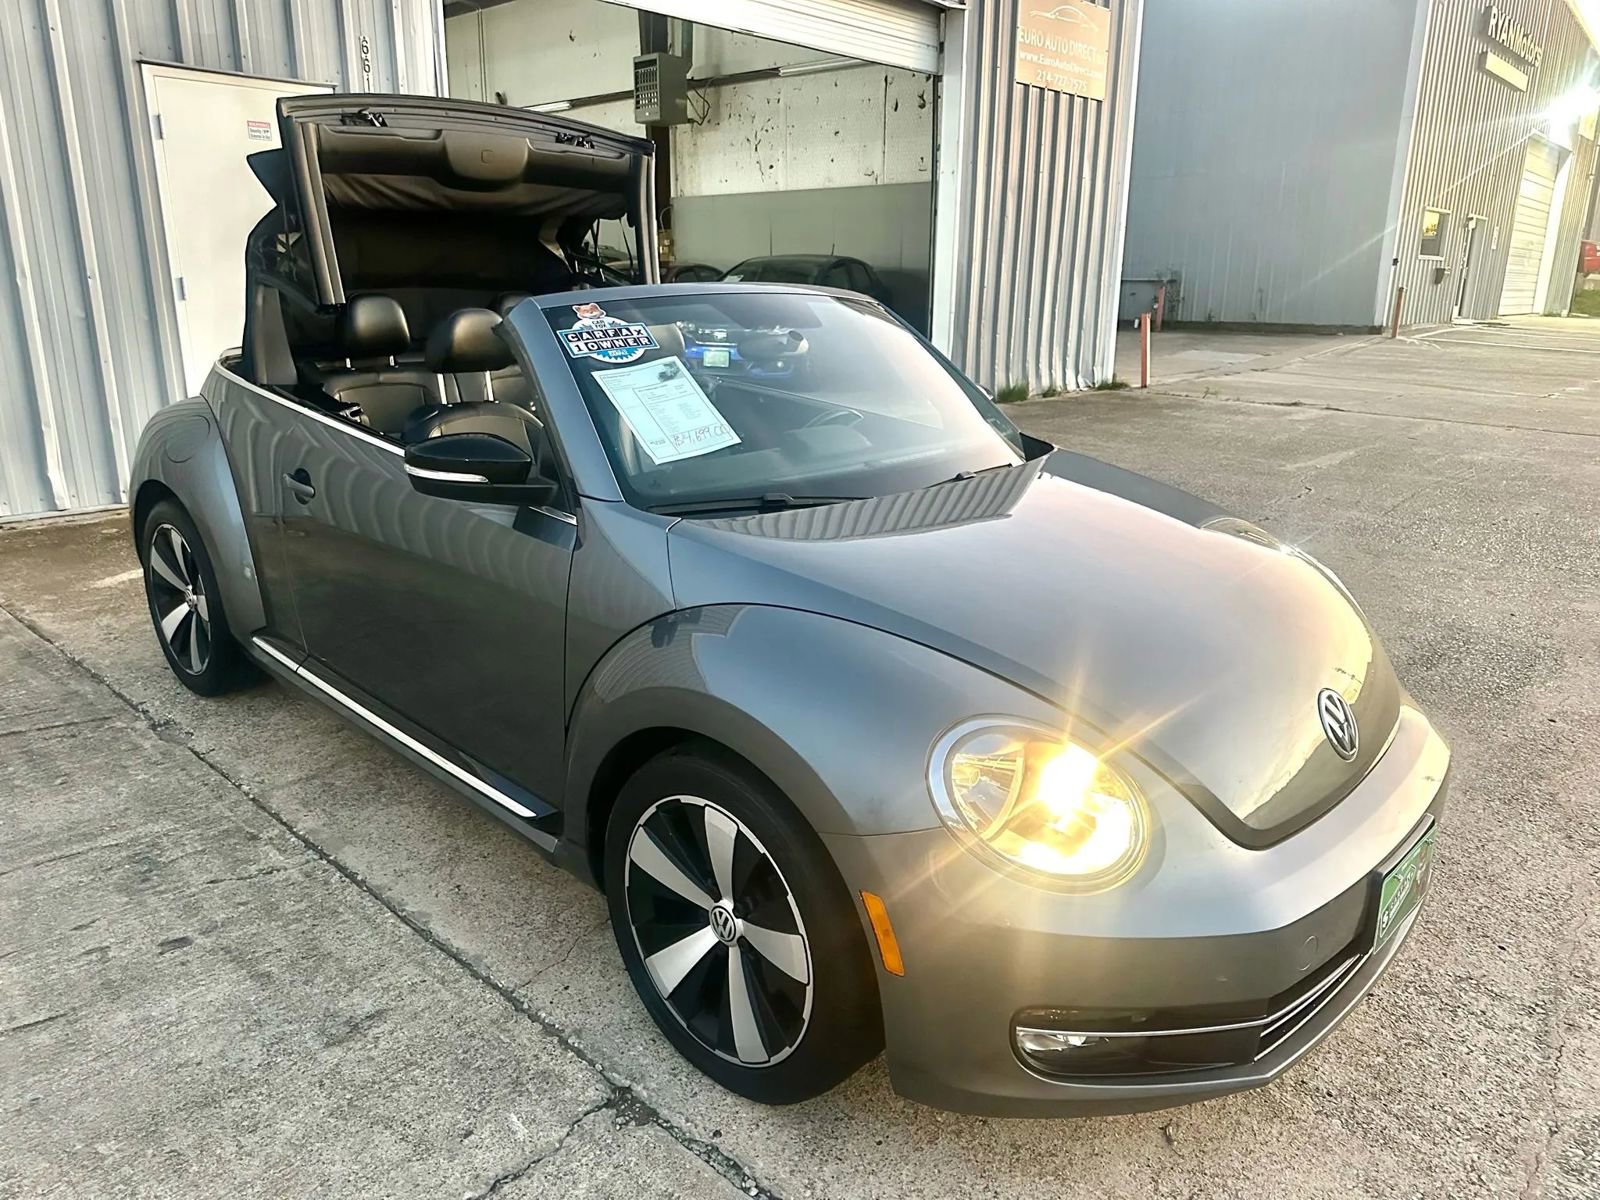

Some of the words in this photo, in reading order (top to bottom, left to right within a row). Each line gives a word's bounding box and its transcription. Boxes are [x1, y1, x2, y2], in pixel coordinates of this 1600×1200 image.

[1019, 27, 1044, 47] EURO
[1045, 34, 1068, 54] AUTO
[1069, 40, 1096, 62] DIRECT
[567, 327, 644, 342] CARFAX
[587, 337, 651, 351] OWNER
